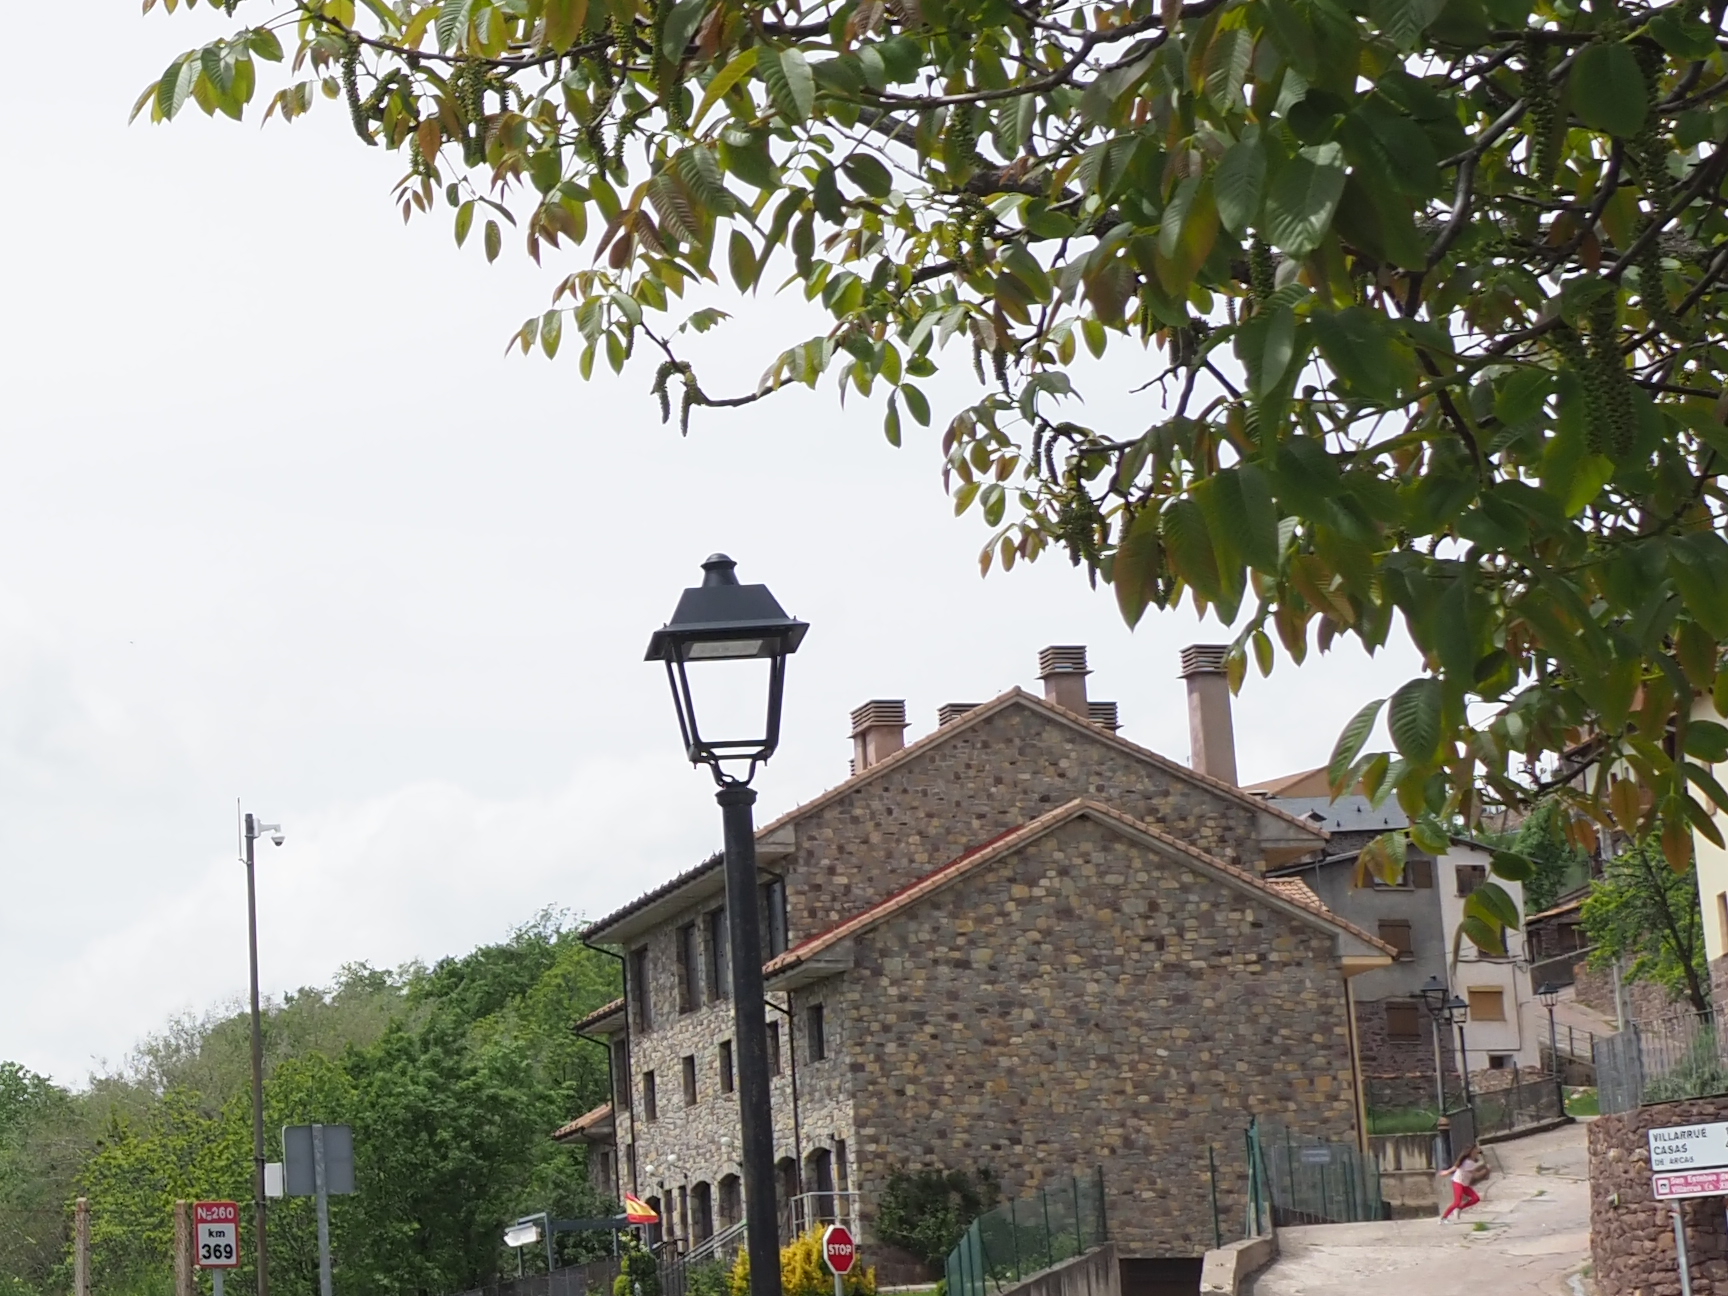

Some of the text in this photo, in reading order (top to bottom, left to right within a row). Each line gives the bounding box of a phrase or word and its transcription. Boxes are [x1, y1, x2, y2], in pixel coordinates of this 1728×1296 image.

[1653, 1143, 1688, 1156] CASAS
[208, 1228, 226, 1238] km
[201, 1243, 233, 1260] 369
[828, 1243, 852, 1256] STOP
